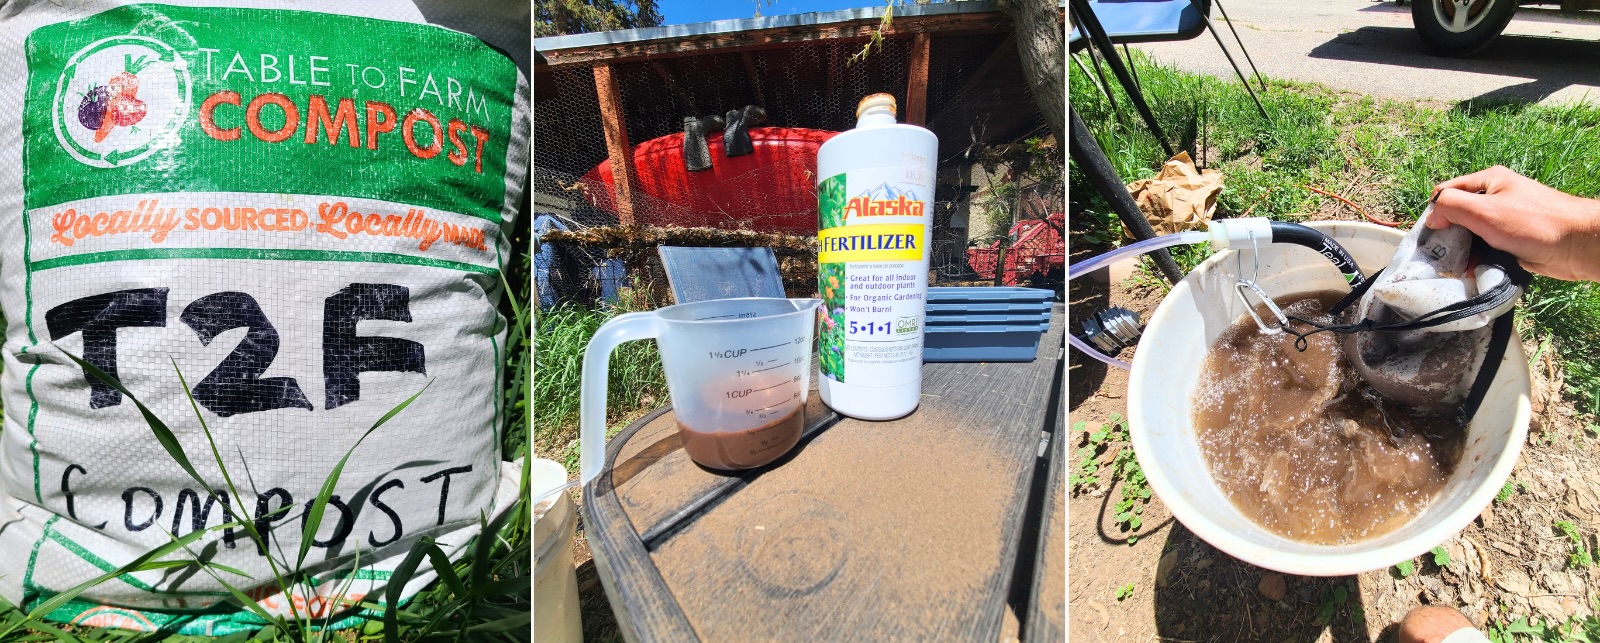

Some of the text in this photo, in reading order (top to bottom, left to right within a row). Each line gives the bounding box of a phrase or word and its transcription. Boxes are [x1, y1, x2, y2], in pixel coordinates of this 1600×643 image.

[198, 47, 490, 121] TABLE TO FARM
[198, 90, 490, 174] COMPOST
[842, 196, 924, 220] Alaska
[51, 198, 182, 247] Locally
[316, 201, 442, 251] Locally
[824, 234, 917, 252] FERTILIZER
[1319, 242, 1347, 268] Teal
[1324, 236, 1339, 251] MADE
[896, 273, 916, 281] indoor
[896, 281, 915, 290] plants
[863, 294, 892, 303] Organic
[45, 282, 427, 418] T2F
